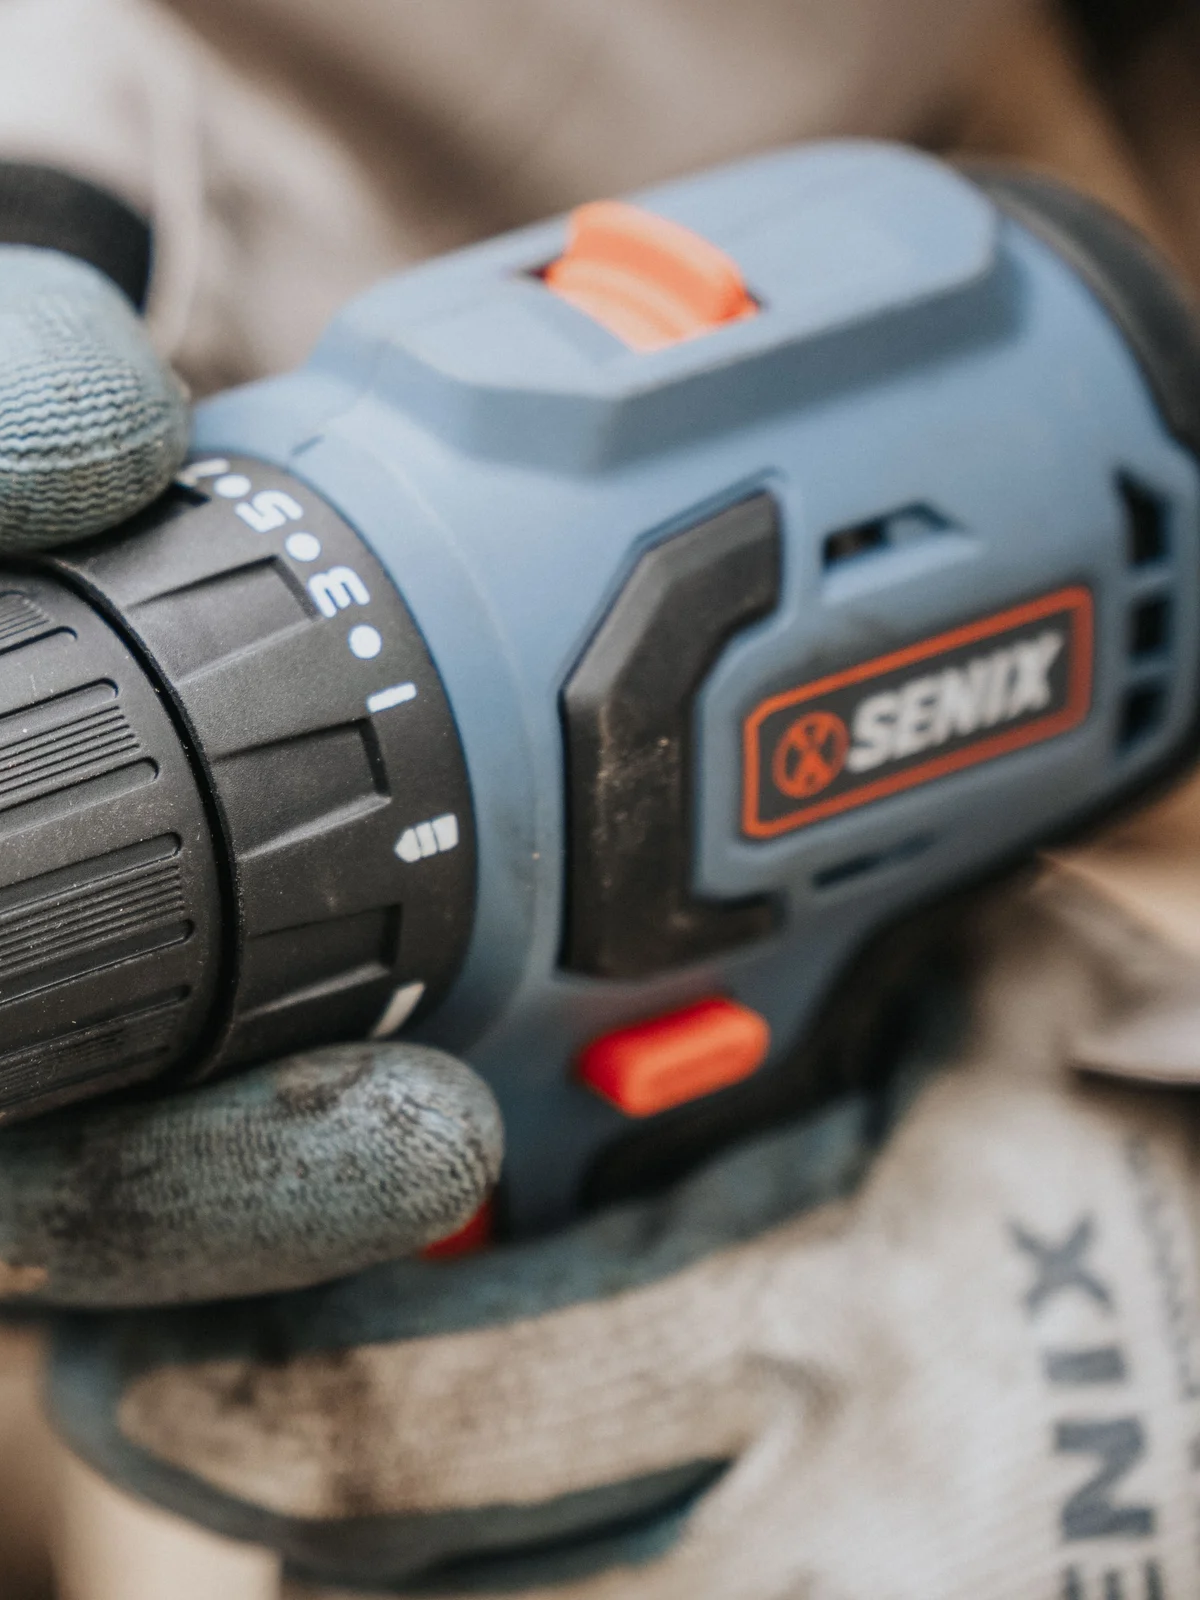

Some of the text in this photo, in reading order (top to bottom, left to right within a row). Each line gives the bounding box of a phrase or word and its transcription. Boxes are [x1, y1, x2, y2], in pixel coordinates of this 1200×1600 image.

[234, 490, 303, 533] 5
[308, 566, 370, 618] 3
[845, 630, 1065, 774] SENIX
